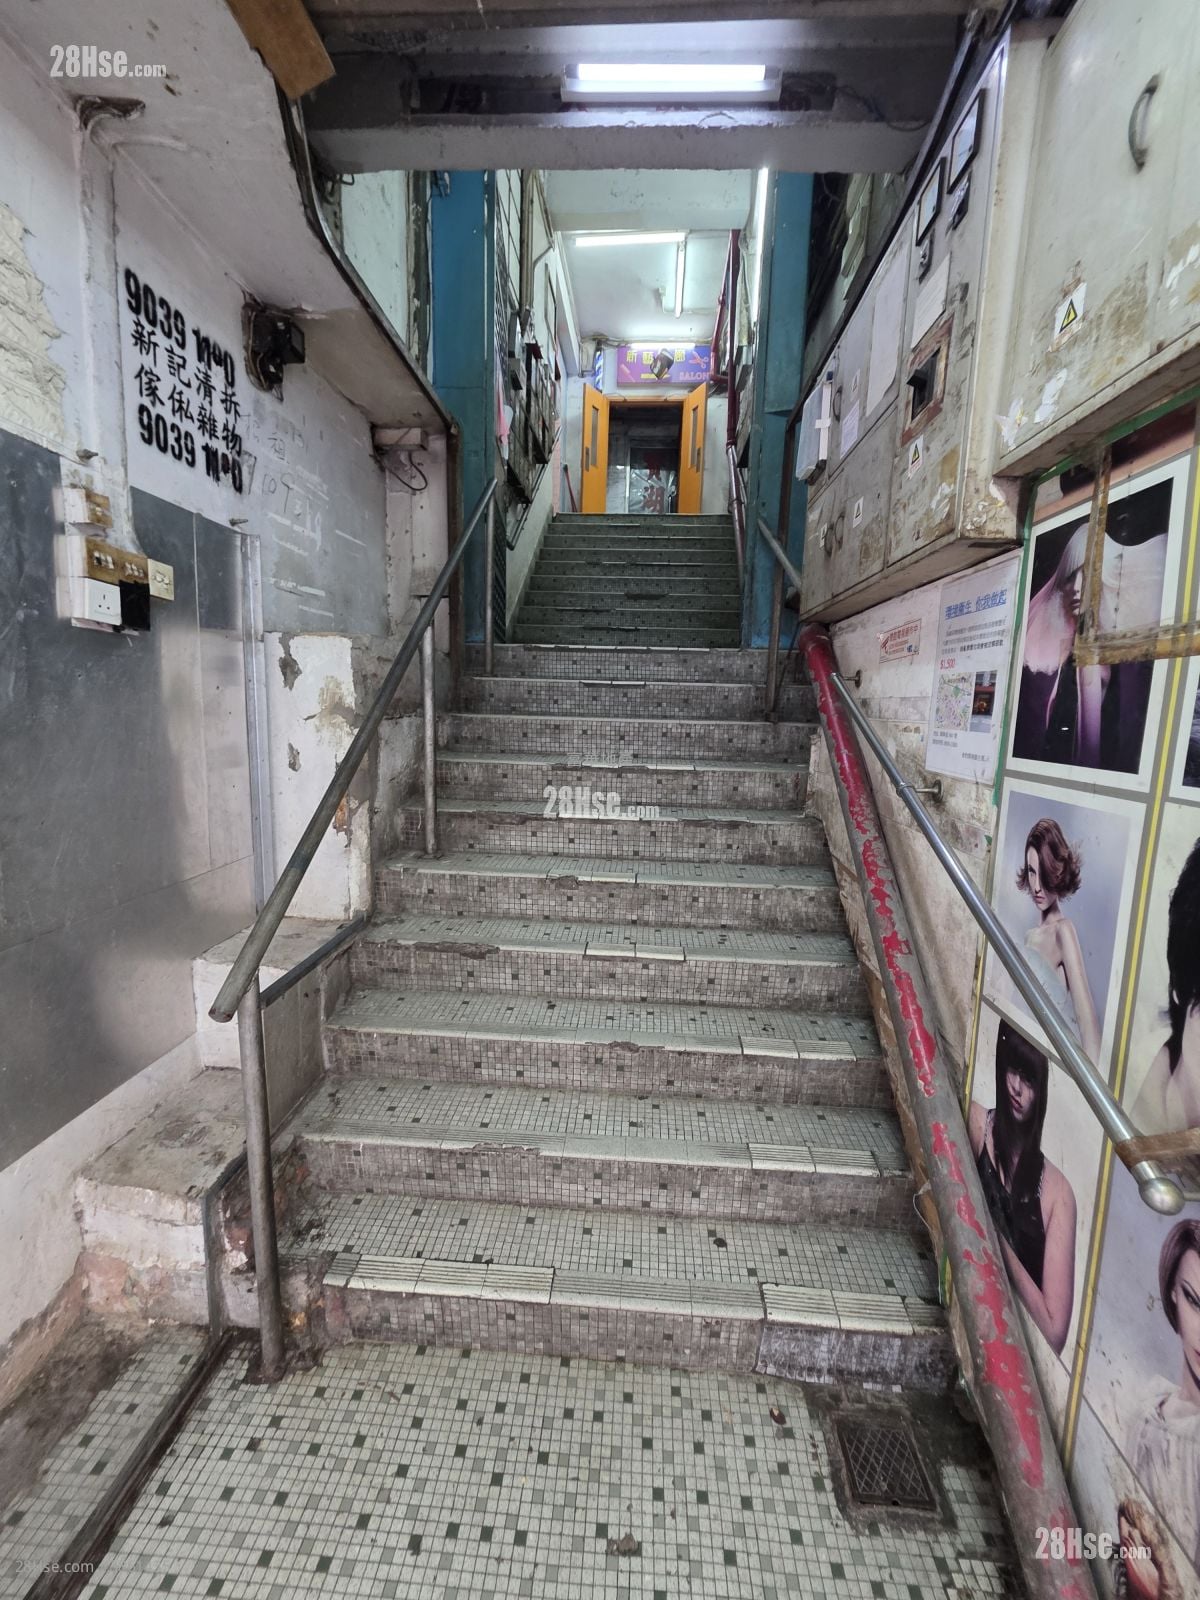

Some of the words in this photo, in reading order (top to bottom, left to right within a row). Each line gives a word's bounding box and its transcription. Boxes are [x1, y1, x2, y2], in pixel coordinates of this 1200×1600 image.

[124, 267, 187, 351] 9039
[131, 314, 242, 424] 新記清拆
[134, 363, 243, 458] 傢俬雜物
[138, 403, 196, 468] 9039
